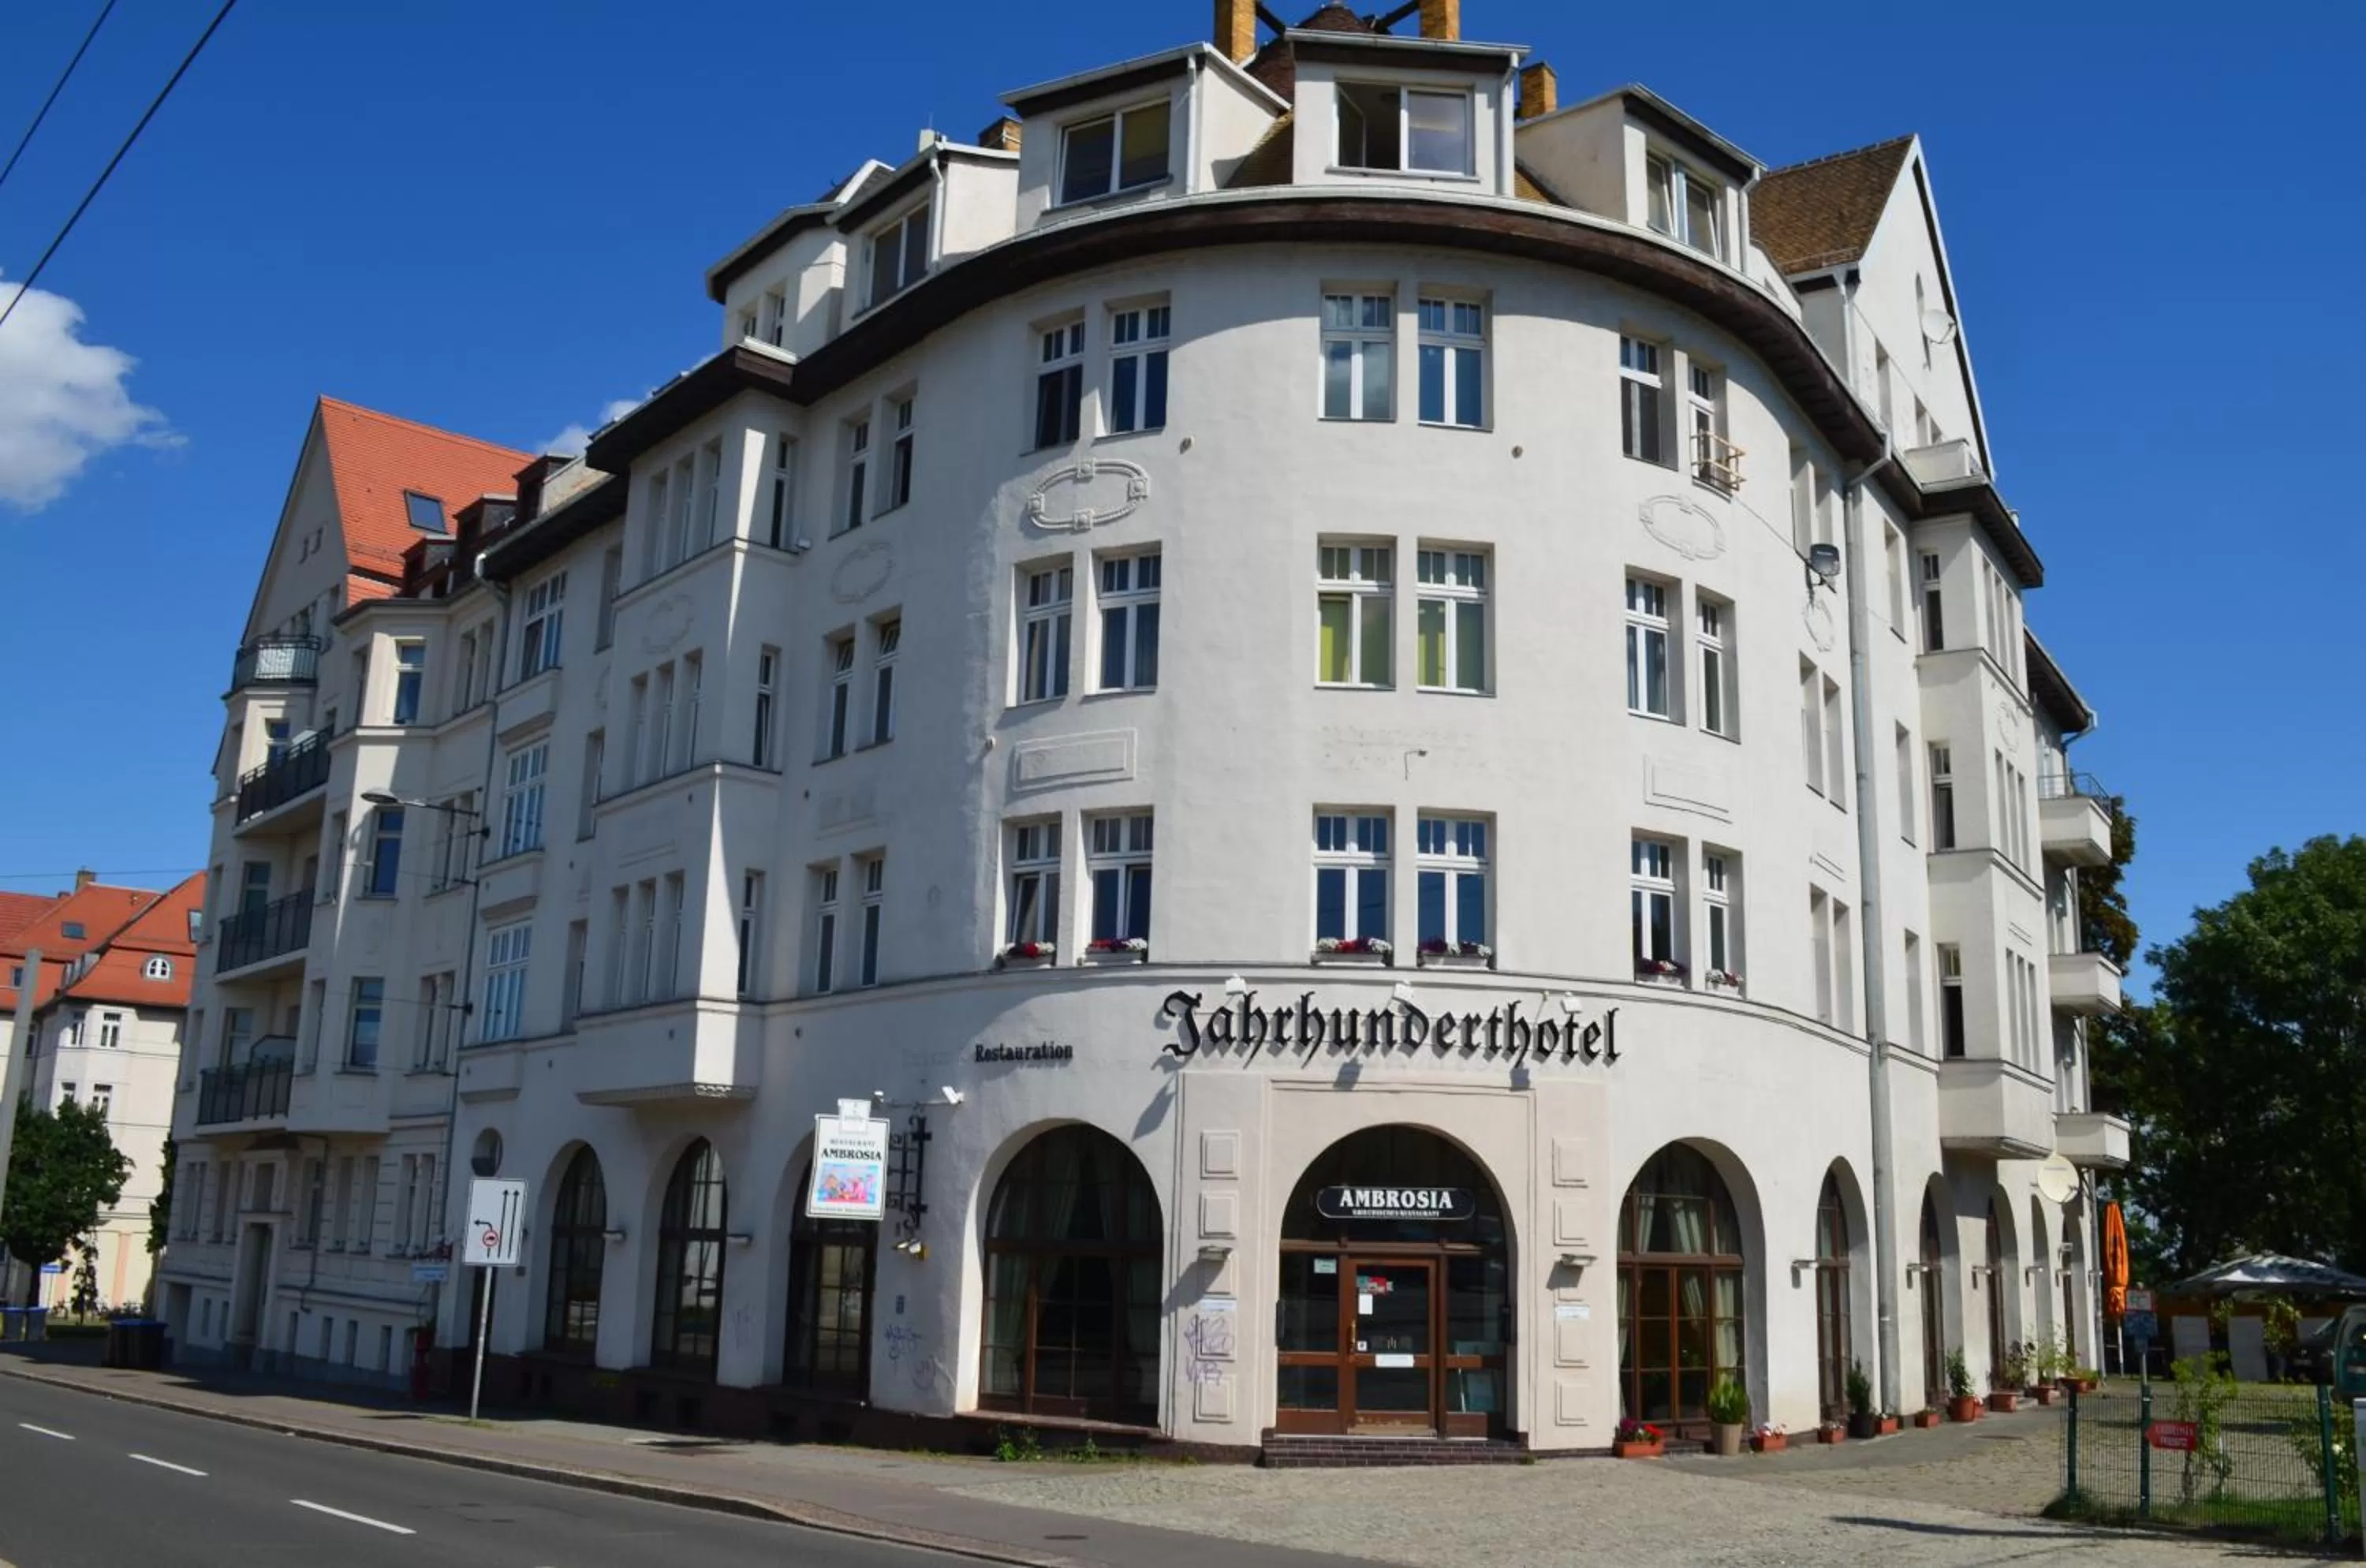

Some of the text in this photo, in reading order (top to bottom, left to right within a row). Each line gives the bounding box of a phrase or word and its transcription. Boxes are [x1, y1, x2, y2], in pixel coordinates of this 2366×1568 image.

[1162, 990, 1620, 1069] Jahrhunderthotel
[975, 1041, 1073, 1062] Restauration
[821, 1148, 883, 1160] AMBROSIA
[1339, 1189, 1454, 1209] AMBROSIA
